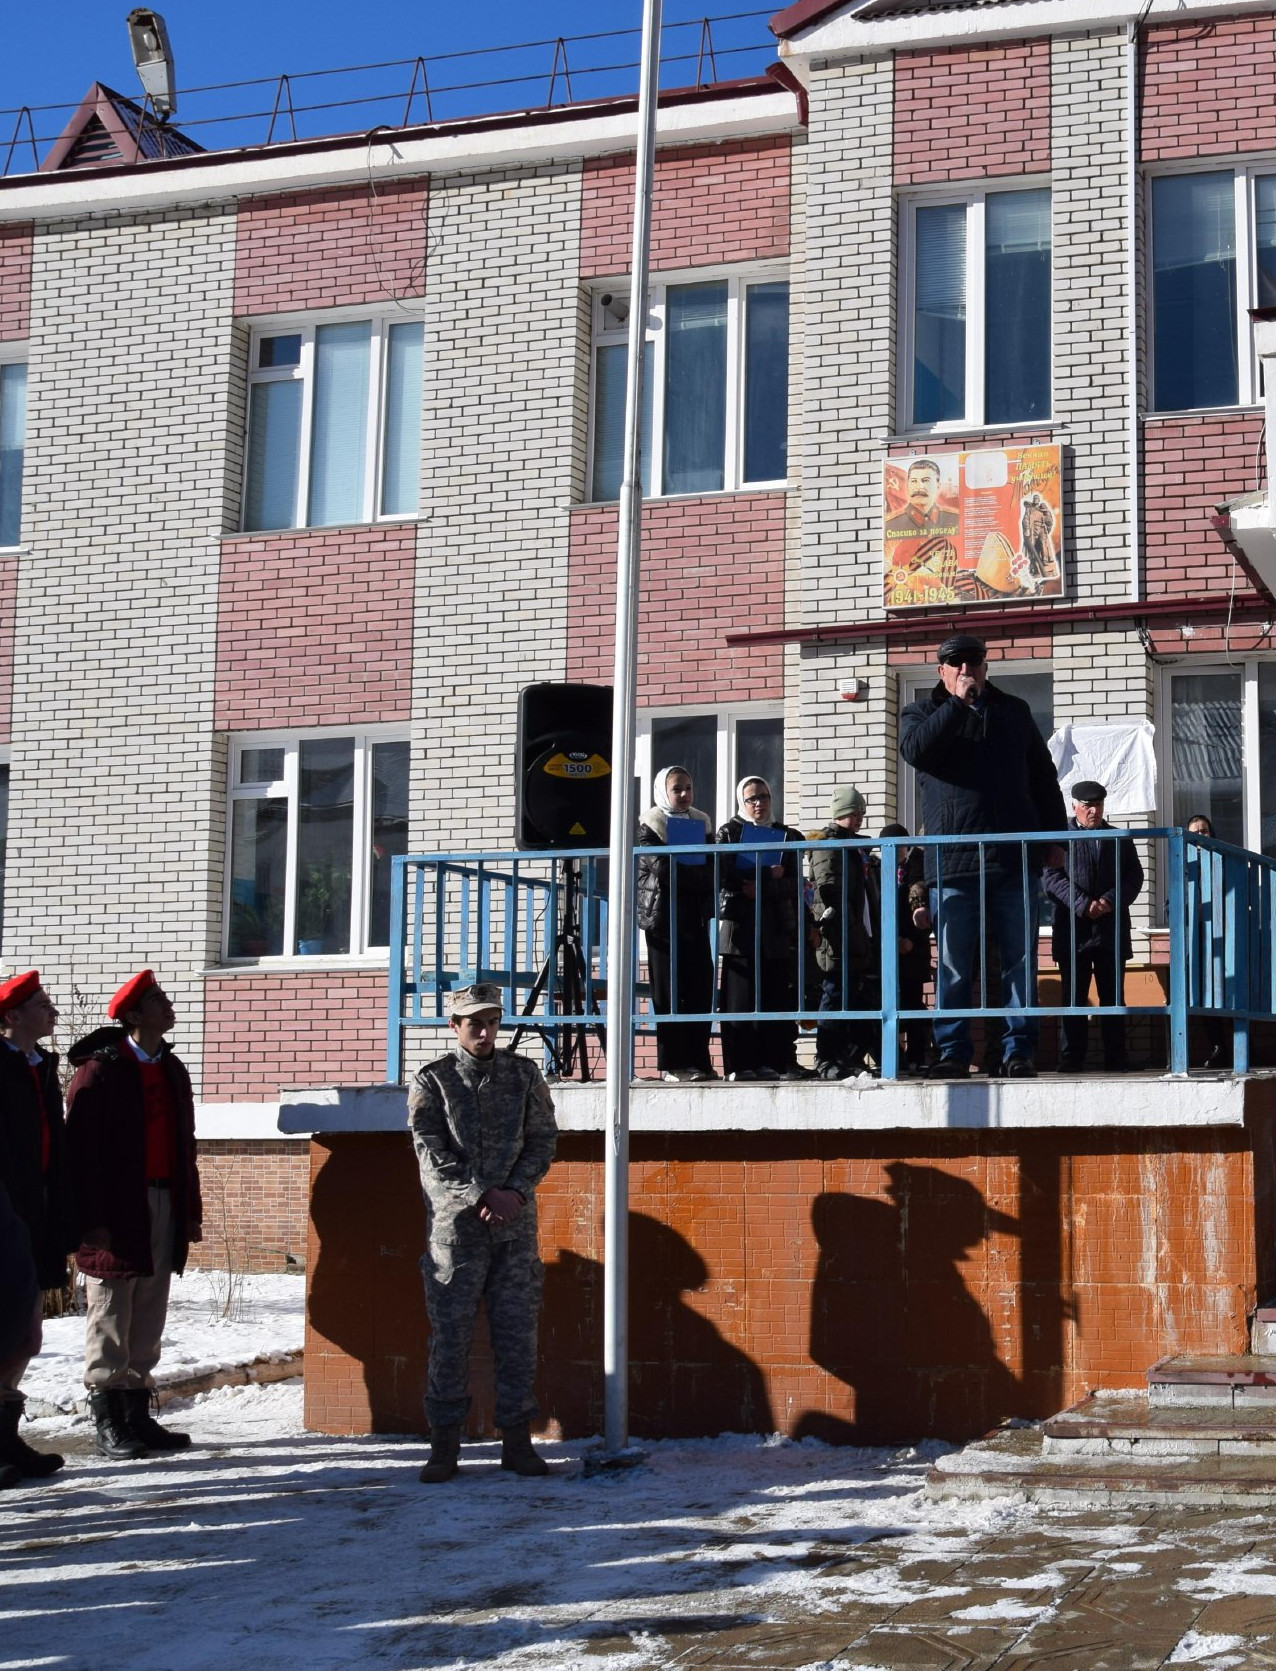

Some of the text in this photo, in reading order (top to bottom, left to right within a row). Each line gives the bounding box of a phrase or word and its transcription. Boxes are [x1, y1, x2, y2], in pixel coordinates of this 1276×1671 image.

[886, 529, 917, 538] Спасибо
[890, 585, 956, 604] 1941-1945
[564, 763, 593, 773] 1500
